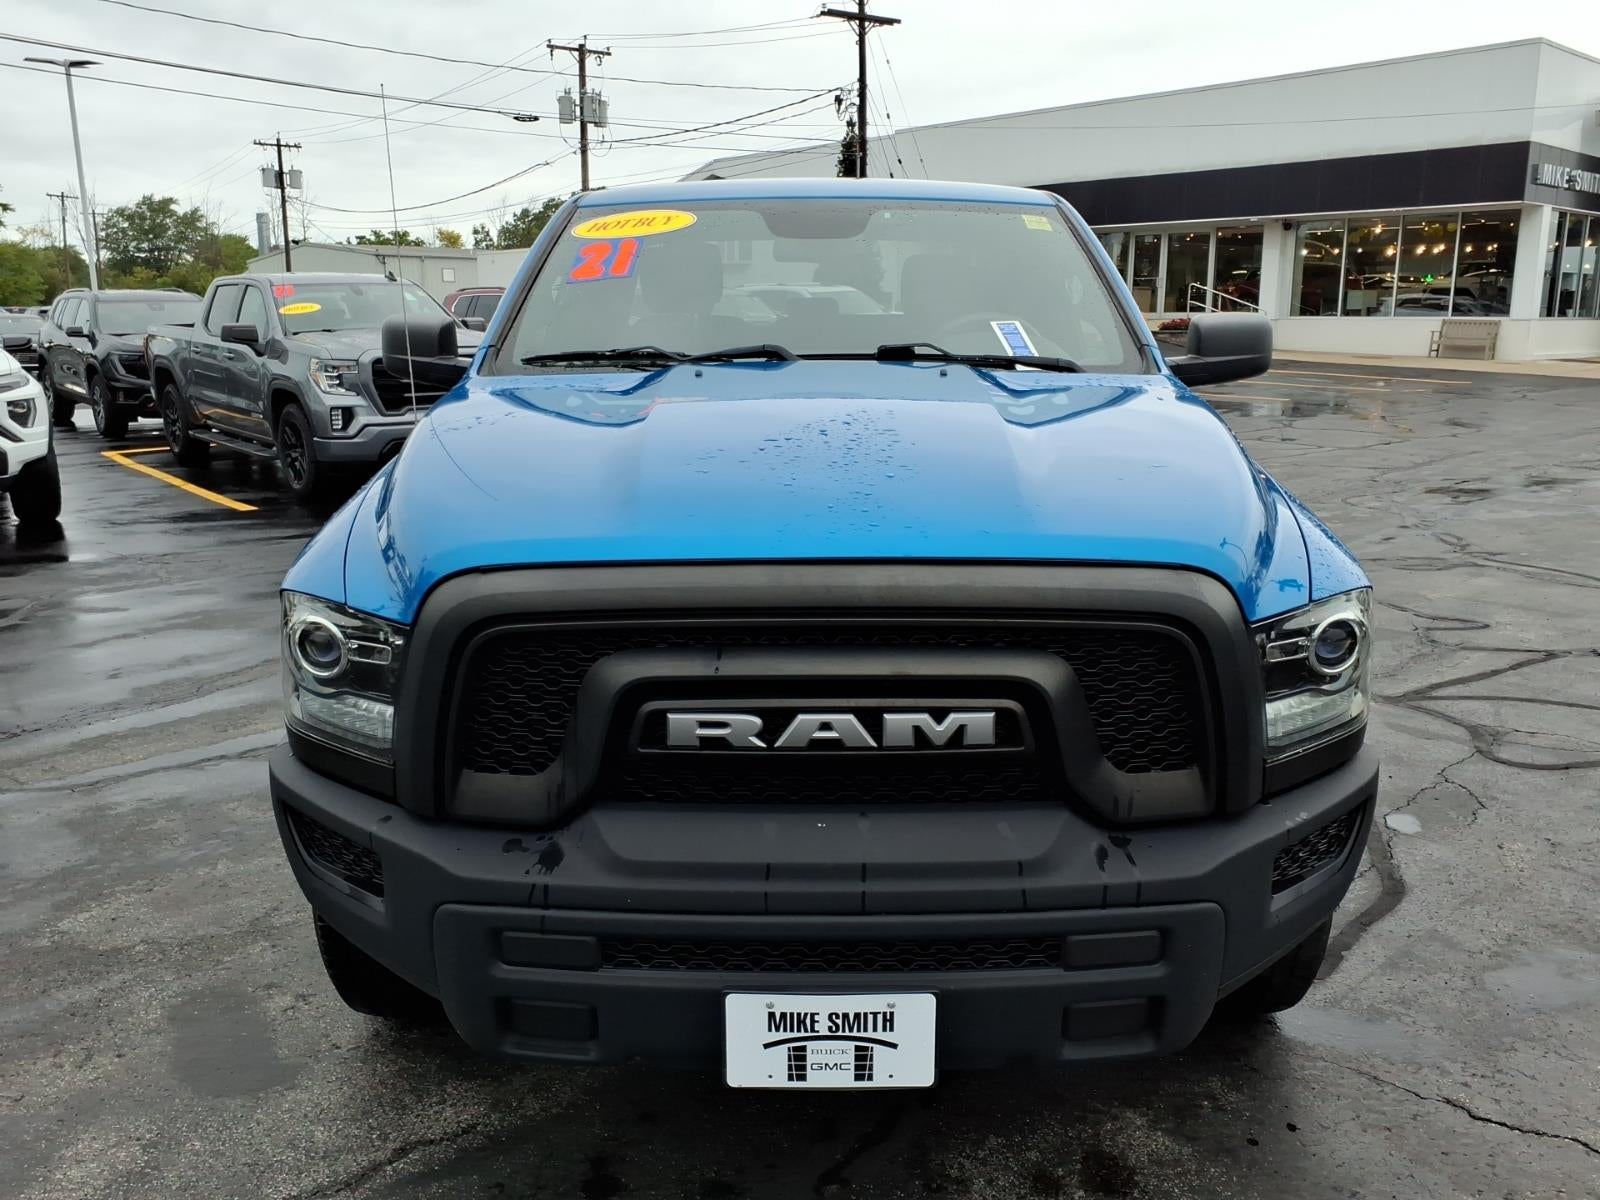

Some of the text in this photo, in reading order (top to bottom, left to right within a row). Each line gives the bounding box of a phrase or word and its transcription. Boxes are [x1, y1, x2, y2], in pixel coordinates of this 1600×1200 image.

[1542, 163, 1600, 194] MIKE SMIT
[569, 238, 640, 281] 21
[666, 711, 996, 748] RAM
[767, 1010, 895, 1034] MIKE SMITH
[810, 1048, 850, 1056] BUICK
[810, 1062, 852, 1071] GMC
